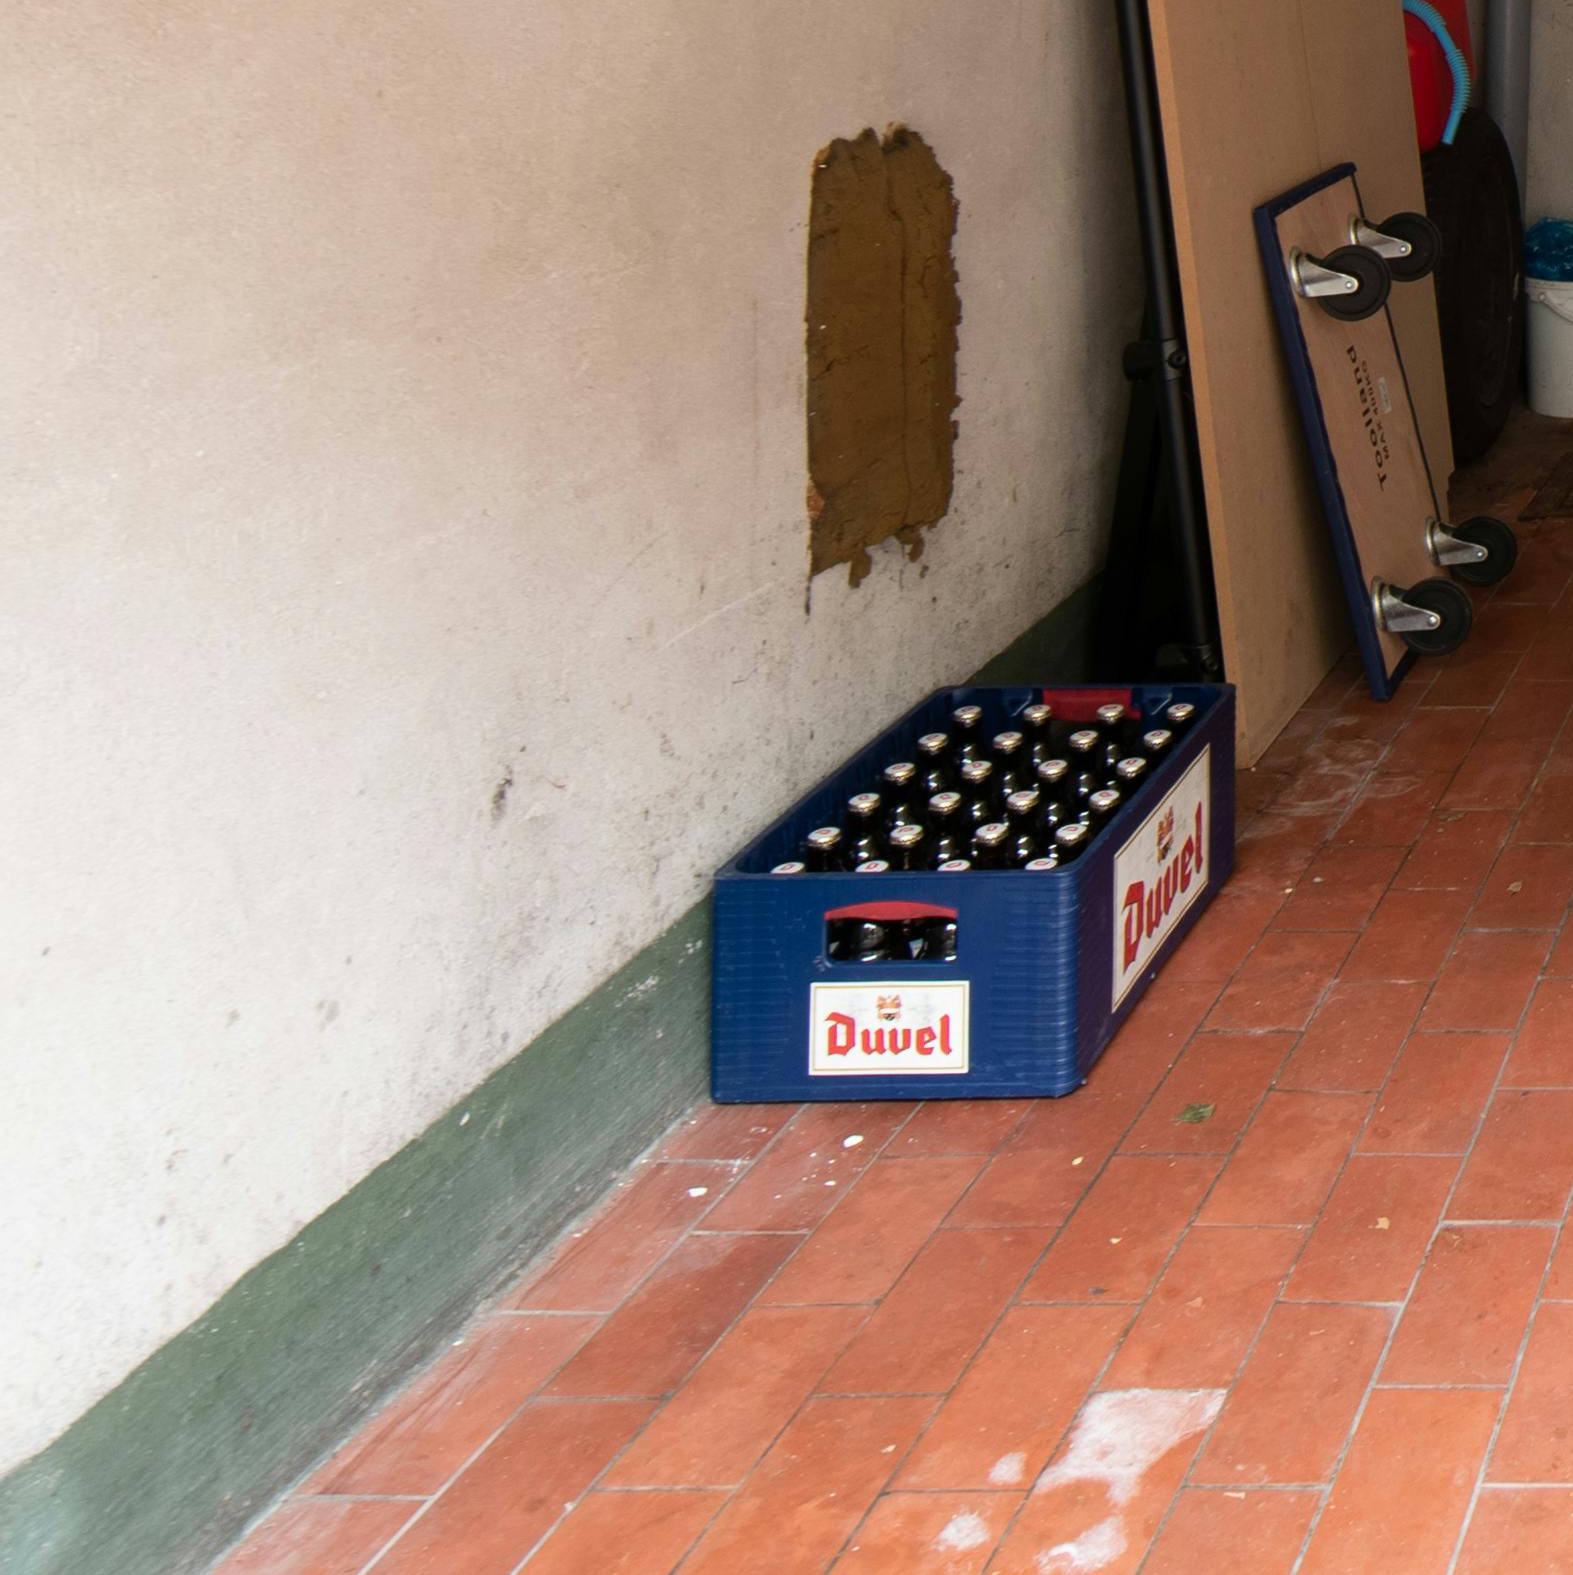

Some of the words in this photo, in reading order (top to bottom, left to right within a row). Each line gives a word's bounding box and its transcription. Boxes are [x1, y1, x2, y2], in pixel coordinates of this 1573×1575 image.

[1346, 344, 1388, 492] Toolland
[1121, 800, 1204, 977] Duvel
[824, 1011, 954, 1058] Duvel
